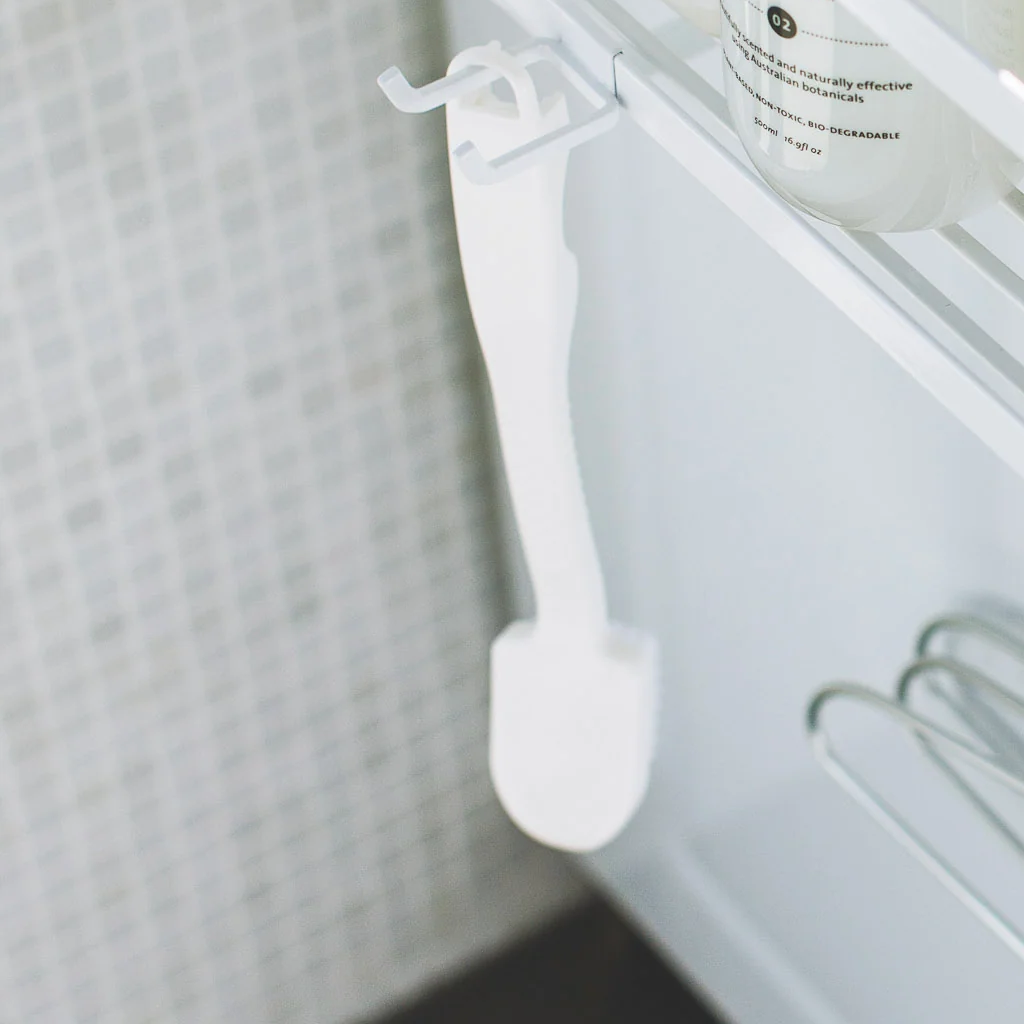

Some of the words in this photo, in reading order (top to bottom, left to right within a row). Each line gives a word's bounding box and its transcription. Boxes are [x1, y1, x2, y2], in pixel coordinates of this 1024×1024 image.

[772, 13, 792, 32] 02
[742, 33, 775, 63] scented
[777, 59, 797, 74] and
[799, 68, 854, 92] naturally
[856, 81, 913, 92] effective
[750, 54, 799, 89] Australian
[802, 81, 865, 104] botanicals
[754, 116, 778, 137] 500ml
[810, 147, 822, 156] oz
[755, 93, 806, 127] NON-TOXIC,
[808, 120, 901, 140] BIO-DEGRADABLE
